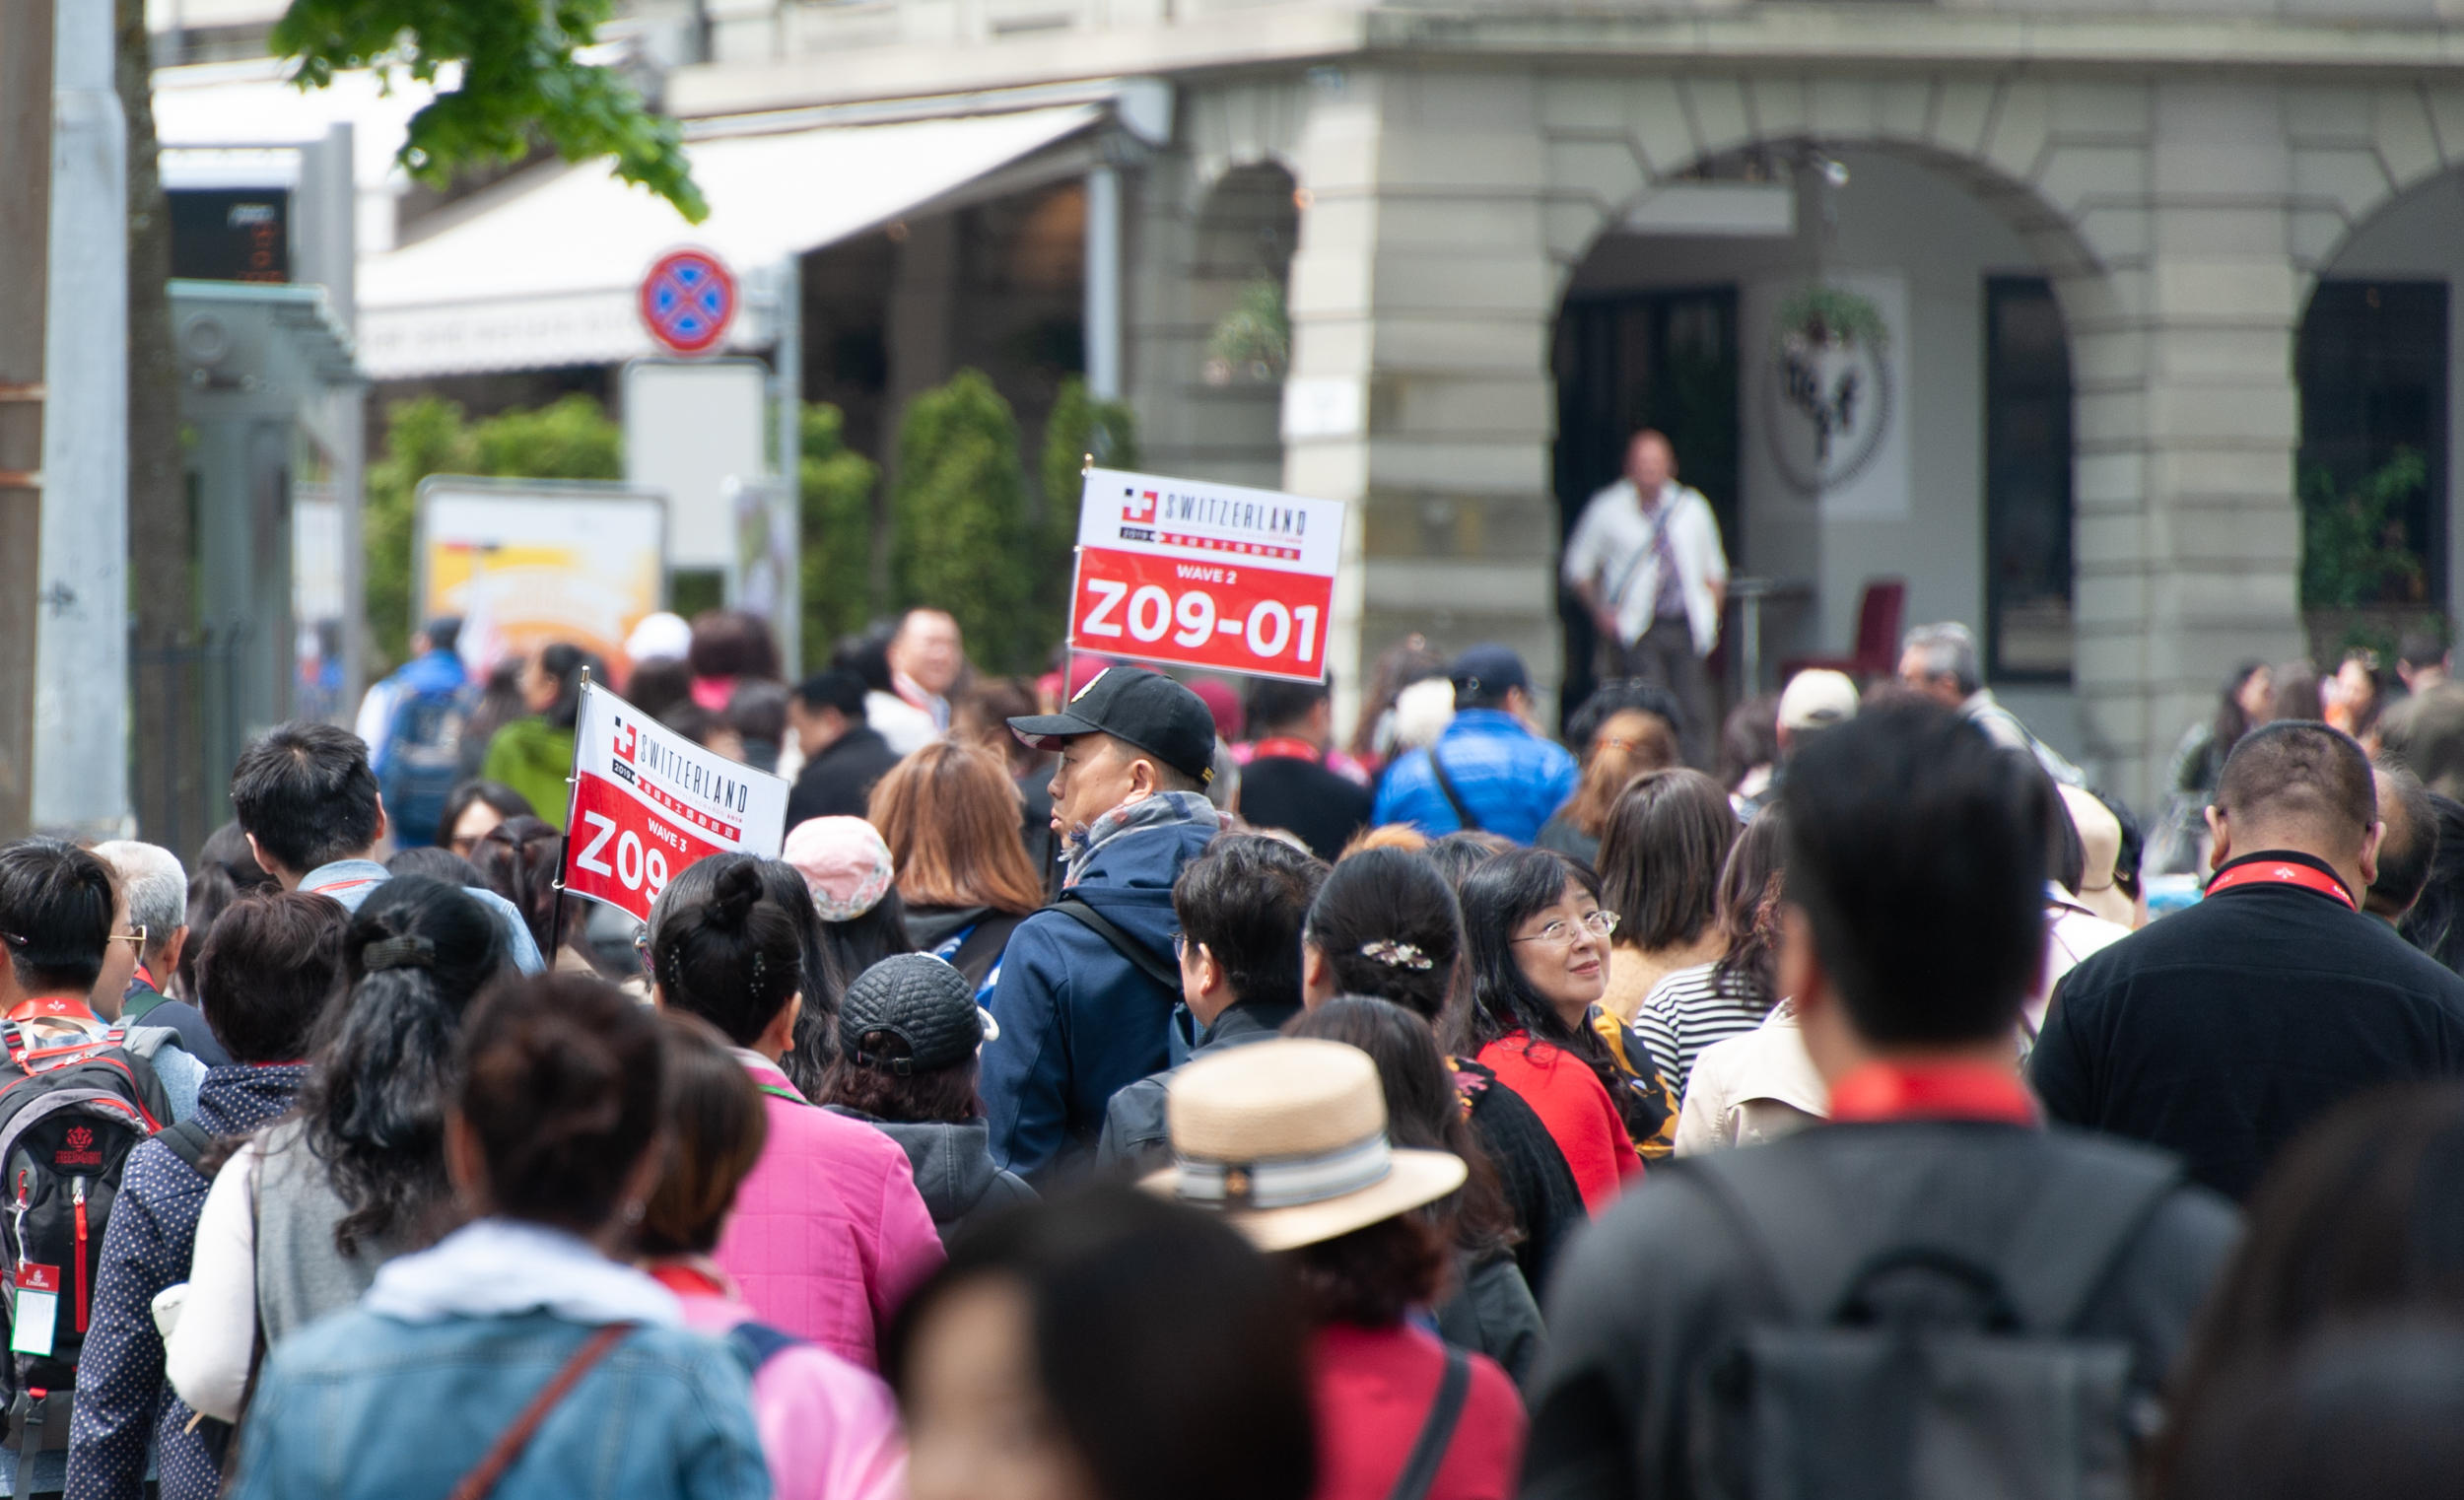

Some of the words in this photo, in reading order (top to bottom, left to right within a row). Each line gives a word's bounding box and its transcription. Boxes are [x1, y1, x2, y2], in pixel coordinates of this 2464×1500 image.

[1164, 494, 1308, 537] SWITZERLAND
[1176, 564, 1223, 583] WAVE
[1225, 571, 1238, 584] 2
[1081, 578, 1320, 663] Z09-01
[613, 763, 632, 780] 2019
[641, 733, 749, 814] SWITZERLAND
[648, 817, 678, 849] WAVE
[679, 839, 687, 852] 3
